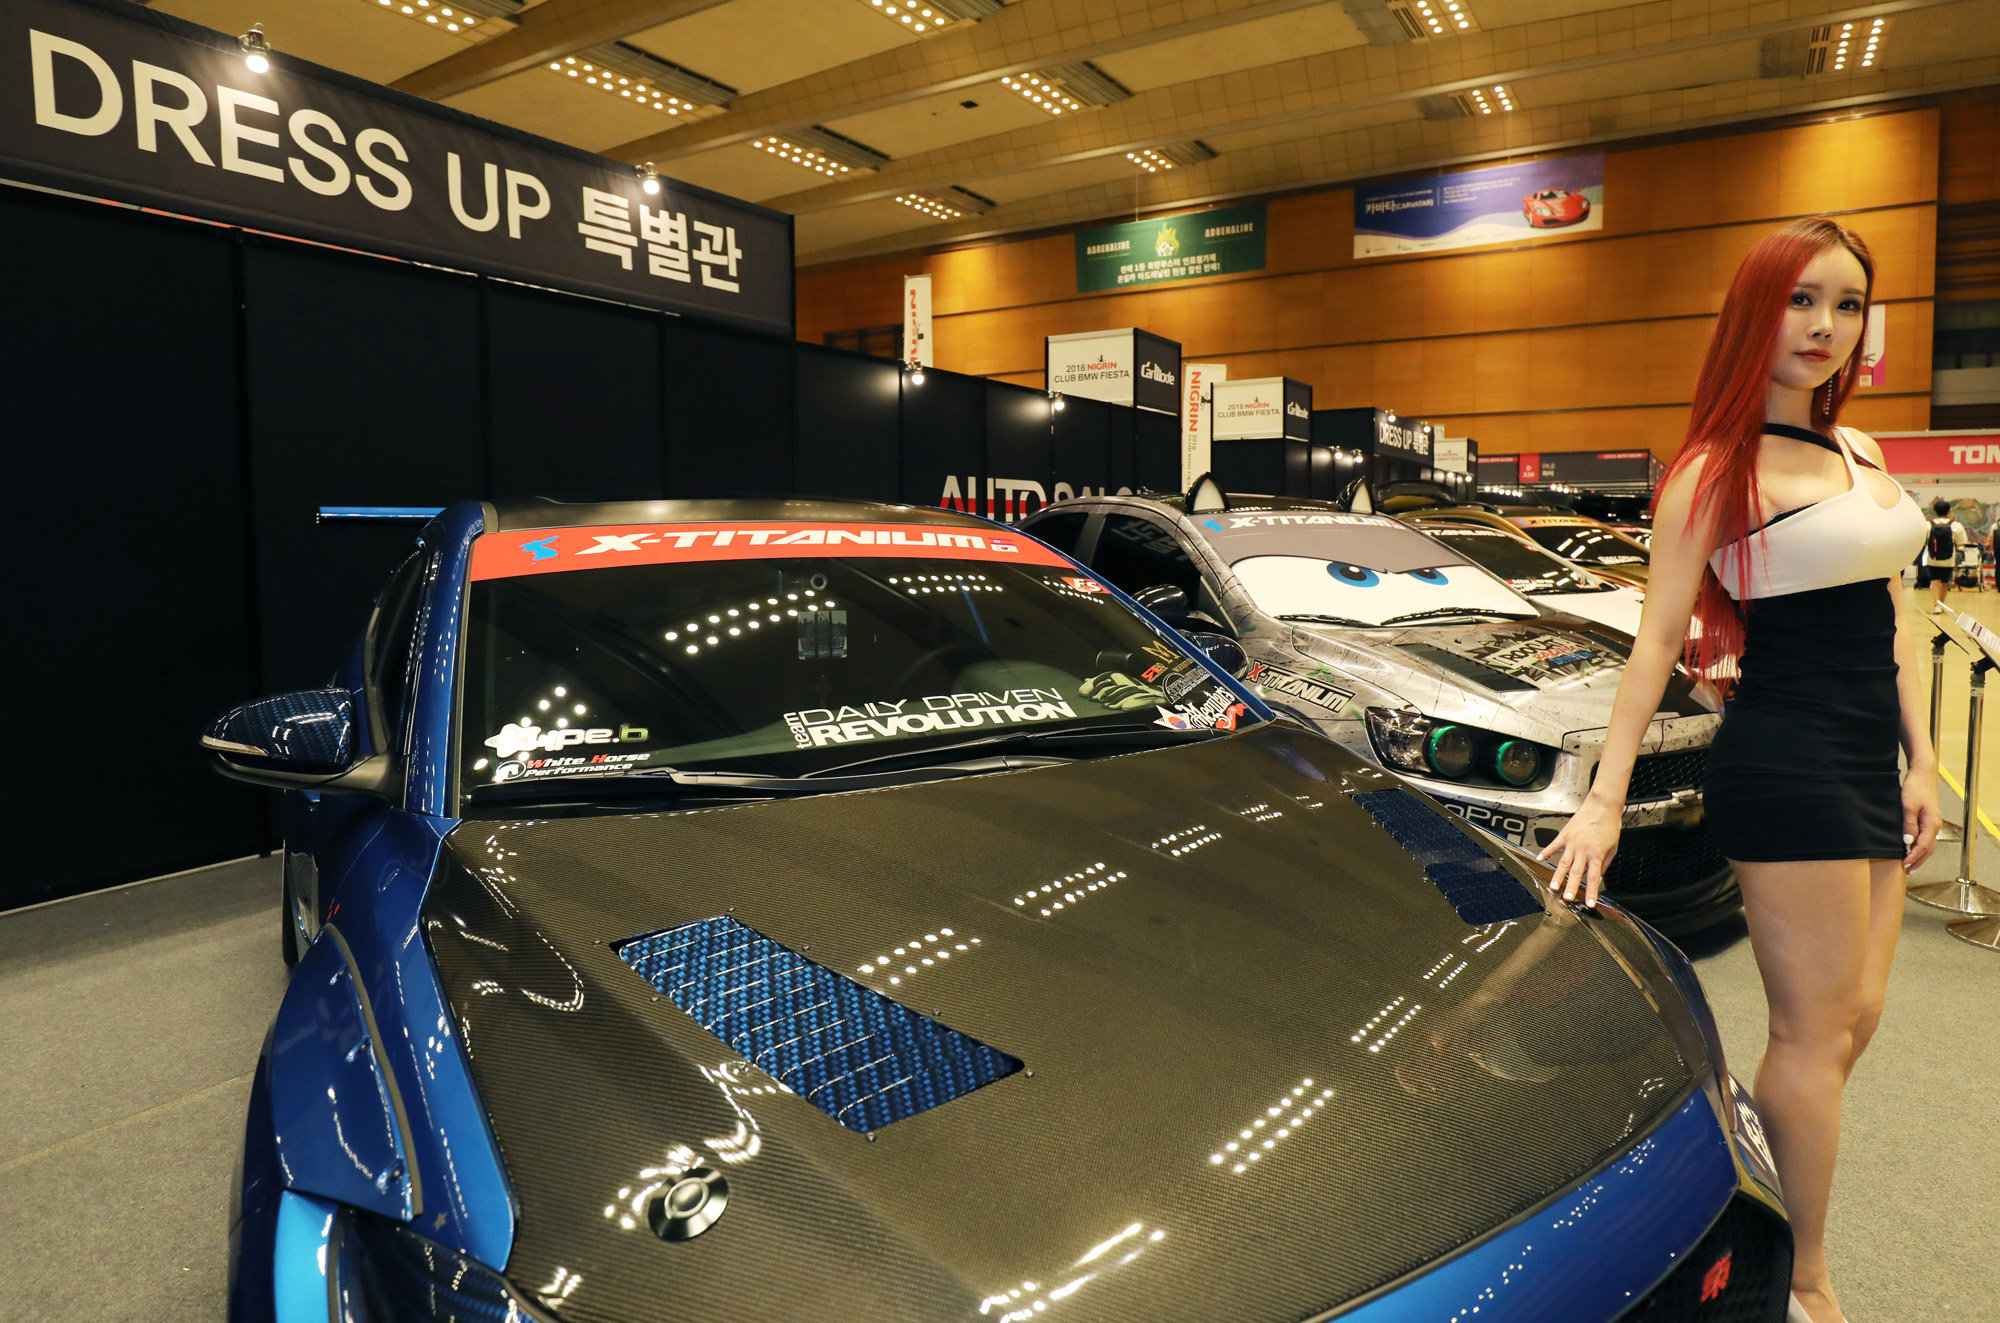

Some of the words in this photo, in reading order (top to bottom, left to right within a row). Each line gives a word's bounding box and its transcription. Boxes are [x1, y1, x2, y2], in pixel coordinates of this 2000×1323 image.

[29, 29, 413, 212] DRESS
[447, 152, 551, 239] UP
[578, 185, 742, 293] 특별관
[1054, 373, 1076, 383] CLUB
[1078, 372, 1099, 382] BMW
[1101, 370, 1130, 379] FIESTA
[1066, 364, 1086, 373] 2018
[1087, 362, 1118, 371] NIGRIN
[1189, 371, 1202, 432] NIGRIN
[1218, 410, 1236, 418] CLUB
[1237, 409, 1254, 417] BMW
[1256, 408, 1280, 416] FIESTA
[1379, 422, 1403, 449] DRESS
[1403, 428, 1412, 451] UP
[940, 475, 1047, 523] AUTO
[1229, 515, 1393, 528] X-TITANIUM
[574, 529, 987, 556] X-TITANIUM
[1073, 578, 1102, 592] FS
[1247, 662, 1350, 713] X-TITANIUM
[798, 698, 908, 726] DAILY
[922, 687, 1063, 711] DRIVEN
[1174, 685, 1236, 731] Meguiar's
[782, 711, 806, 750] team
[807, 701, 1077, 747] REVOLUTION
[524, 763, 633, 778] Performance
[527, 756, 586, 769] White
[590, 752, 650, 765] Horse
[1444, 803, 1525, 833] oPro
